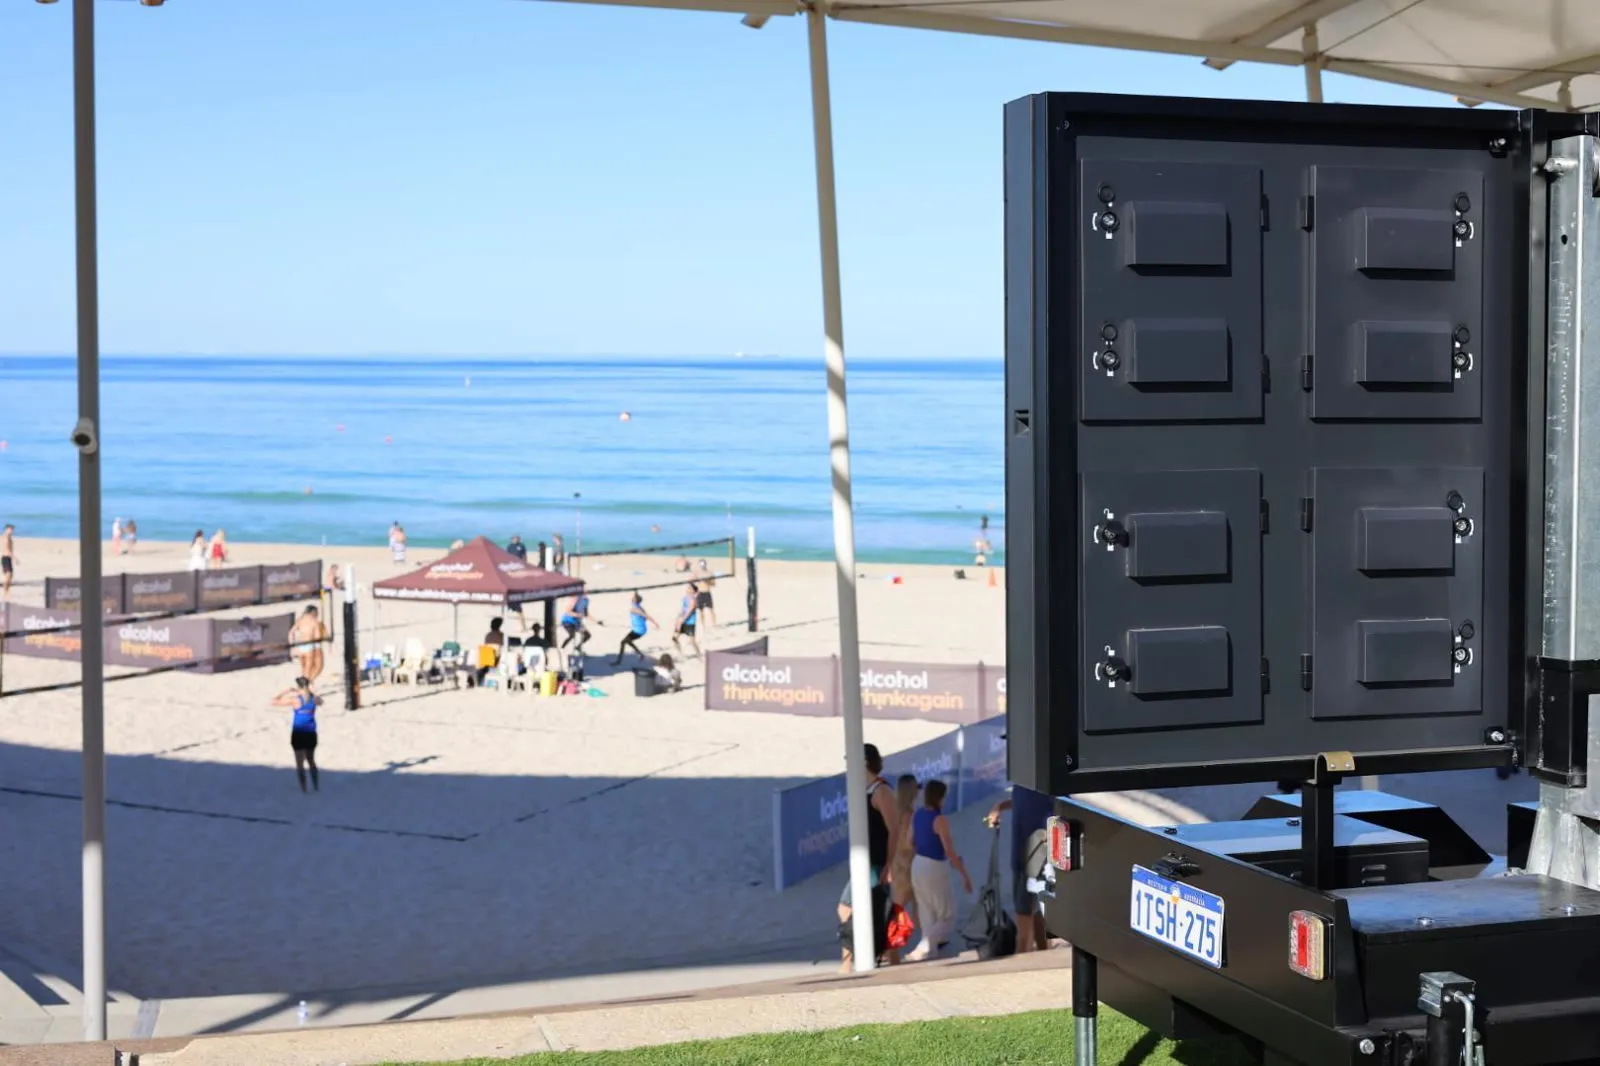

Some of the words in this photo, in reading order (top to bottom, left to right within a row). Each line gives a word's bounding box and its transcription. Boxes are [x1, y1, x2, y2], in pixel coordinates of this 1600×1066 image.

[119, 624, 170, 643] alcohol
[722, 663, 791, 684] alcohol
[723, 682, 824, 706] thinkagain
[861, 688, 964, 712] hinkagain
